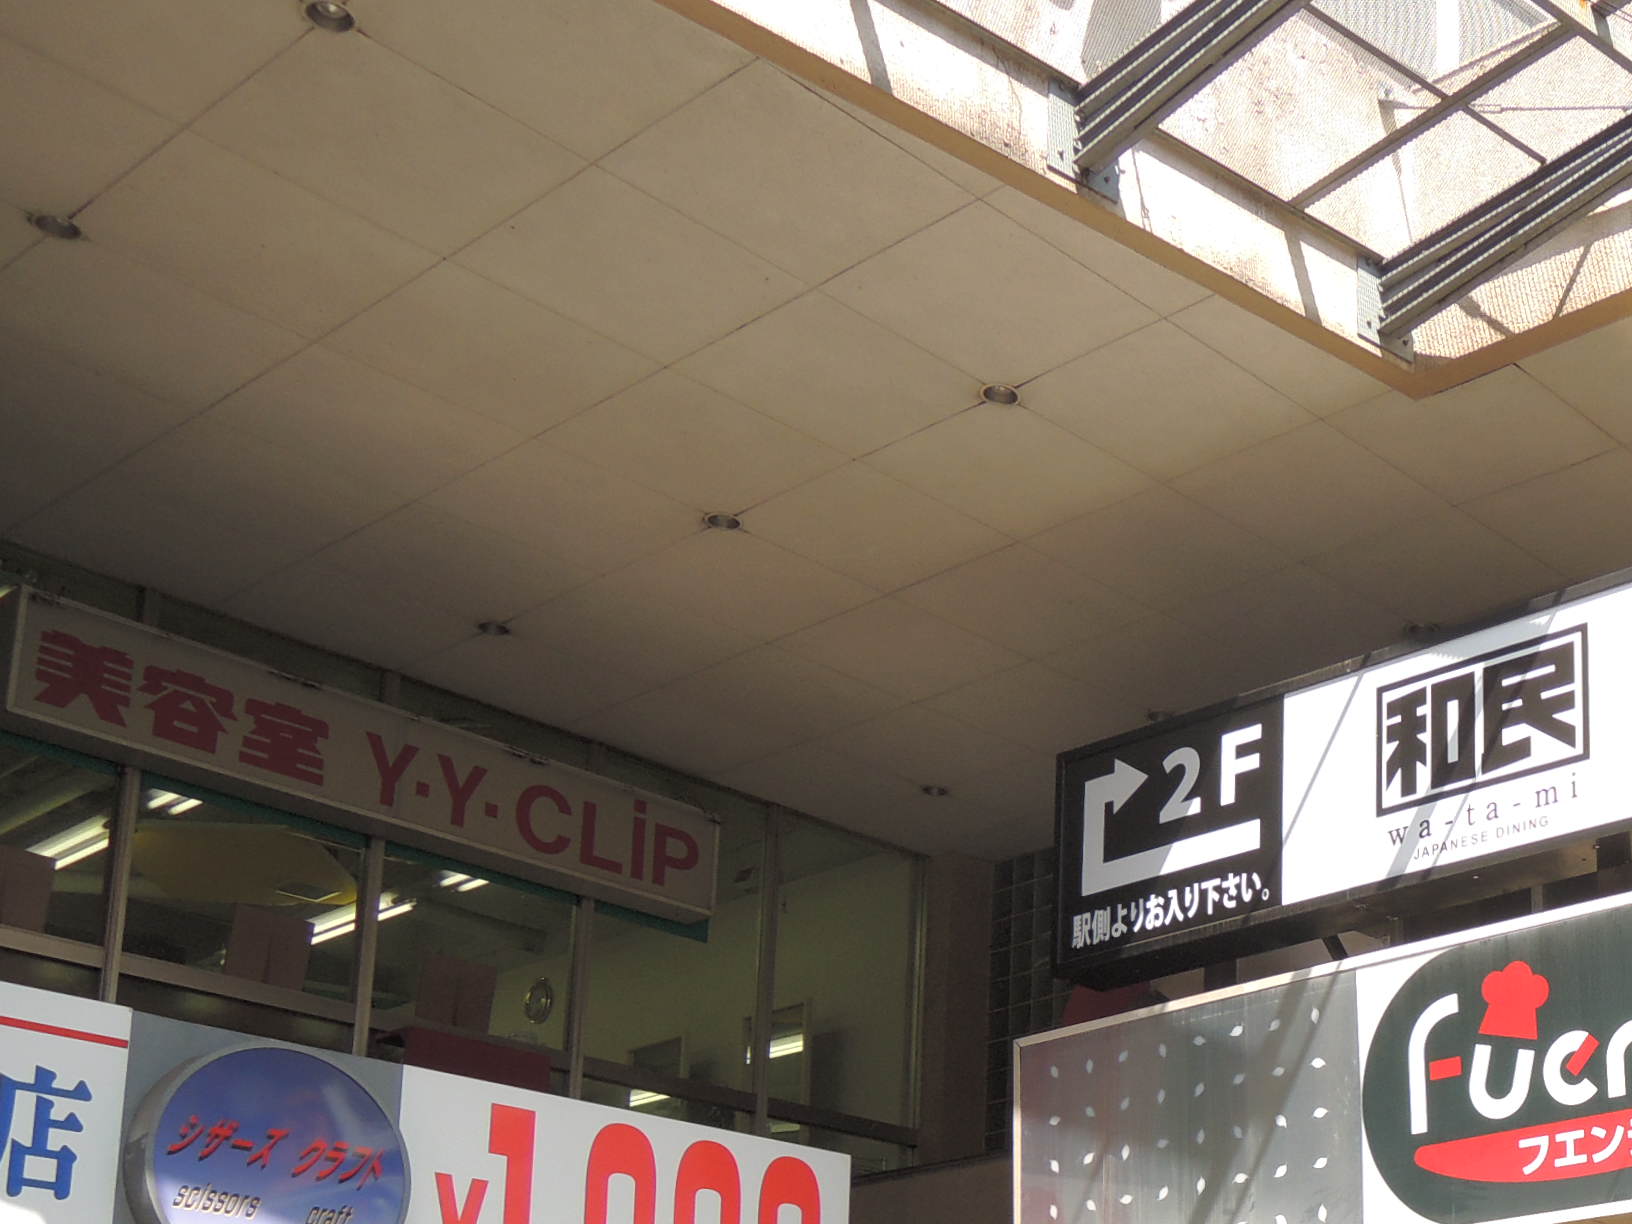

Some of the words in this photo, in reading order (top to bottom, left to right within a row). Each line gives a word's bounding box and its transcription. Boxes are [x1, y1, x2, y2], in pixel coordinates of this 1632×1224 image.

[35, 629, 330, 787] 美容室
[1386, 636, 1576, 799] 和民
[1158, 722, 1263, 825] 2F
[1413, 829, 1489, 861] JAPANESE
[1495, 815, 1550, 841] DINING
[1072, 872, 1271, 950] 駅側よりお入り下さい。
[0, 1064, 93, 1201] 店
[166, 1114, 291, 1171] シザーズ
[291, 1138, 384, 1193] クラフト
[172, 1181, 261, 1223] scissors
